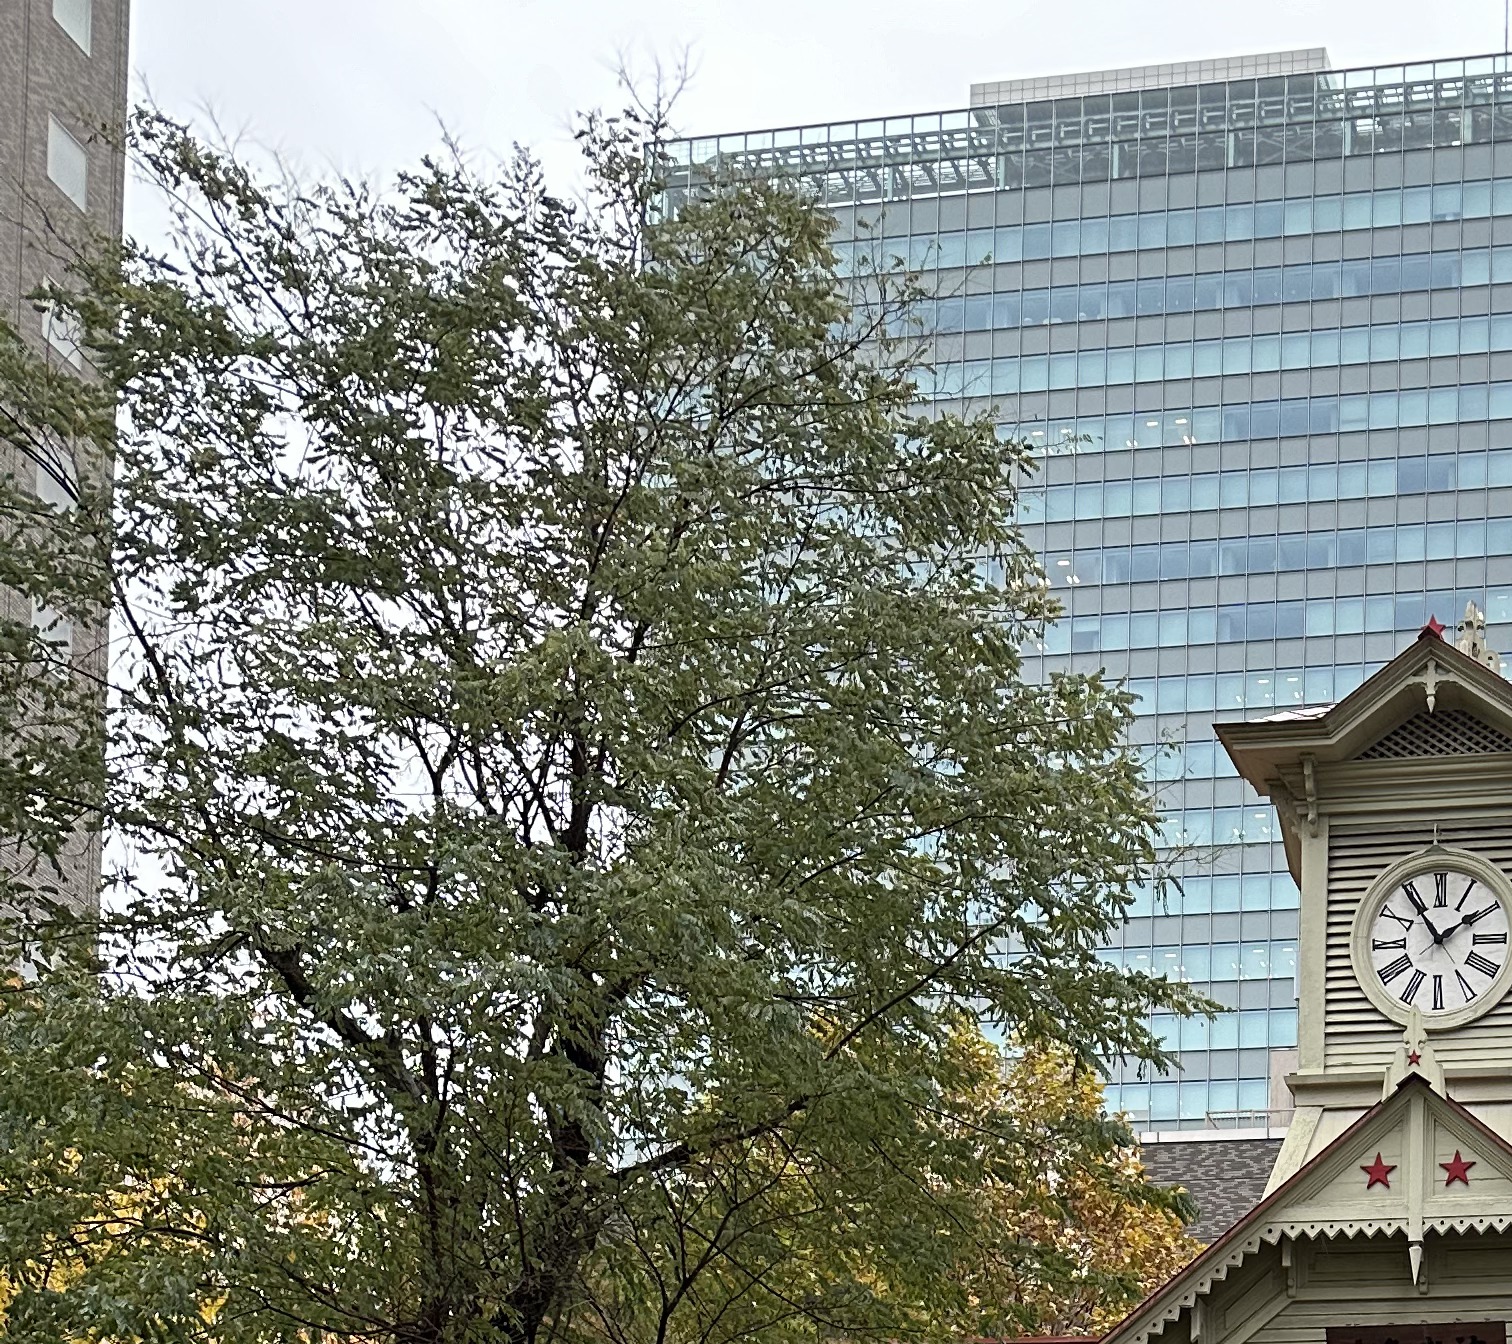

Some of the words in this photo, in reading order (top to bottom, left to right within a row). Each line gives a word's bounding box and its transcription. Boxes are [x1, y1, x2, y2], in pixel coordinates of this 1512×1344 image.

[1379, 904, 1415, 932] X
[1472, 932, 1508, 946] III
[1455, 969, 1478, 1002] V
